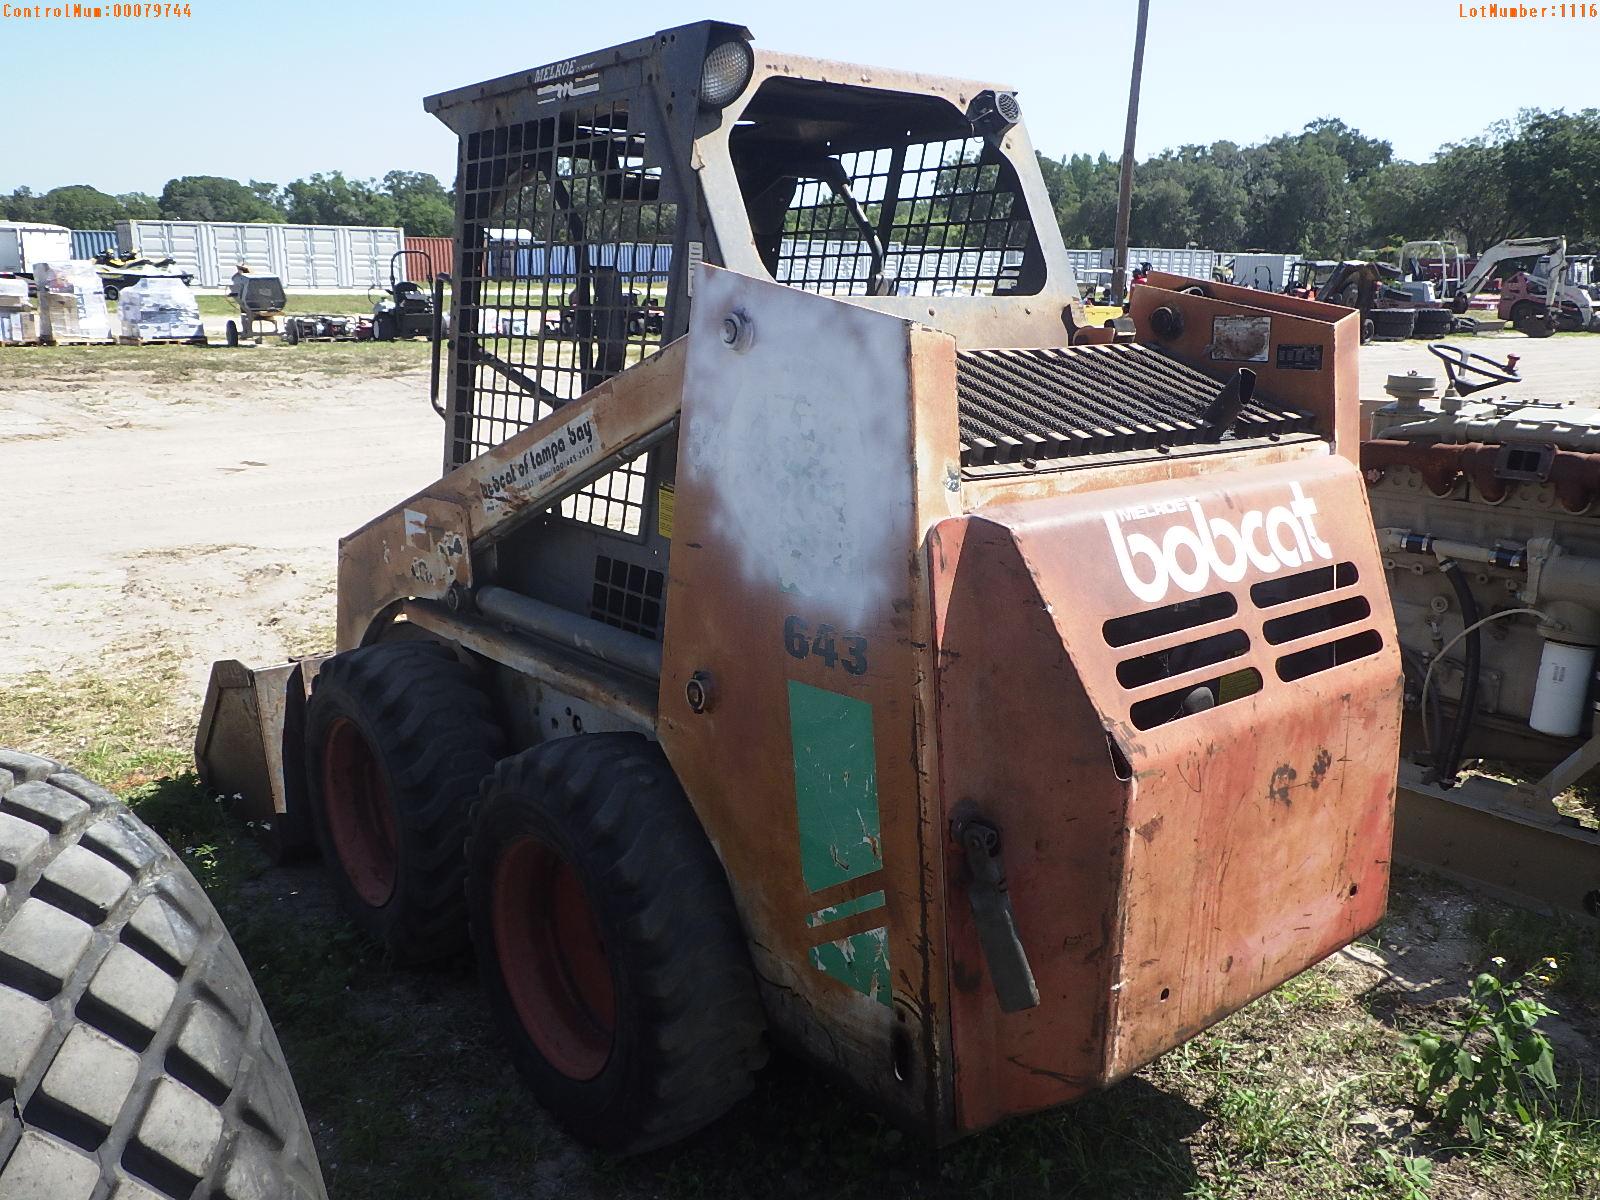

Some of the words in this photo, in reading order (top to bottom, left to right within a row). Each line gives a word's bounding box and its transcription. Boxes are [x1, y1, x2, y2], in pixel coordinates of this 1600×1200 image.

[534, 59, 577, 83] MELROE
[518, 452, 529, 477] of
[566, 420, 593, 446] bay
[1117, 496, 1188, 523] MELROE
[1101, 480, 1333, 603] bobcat
[783, 614, 868, 676] 643
